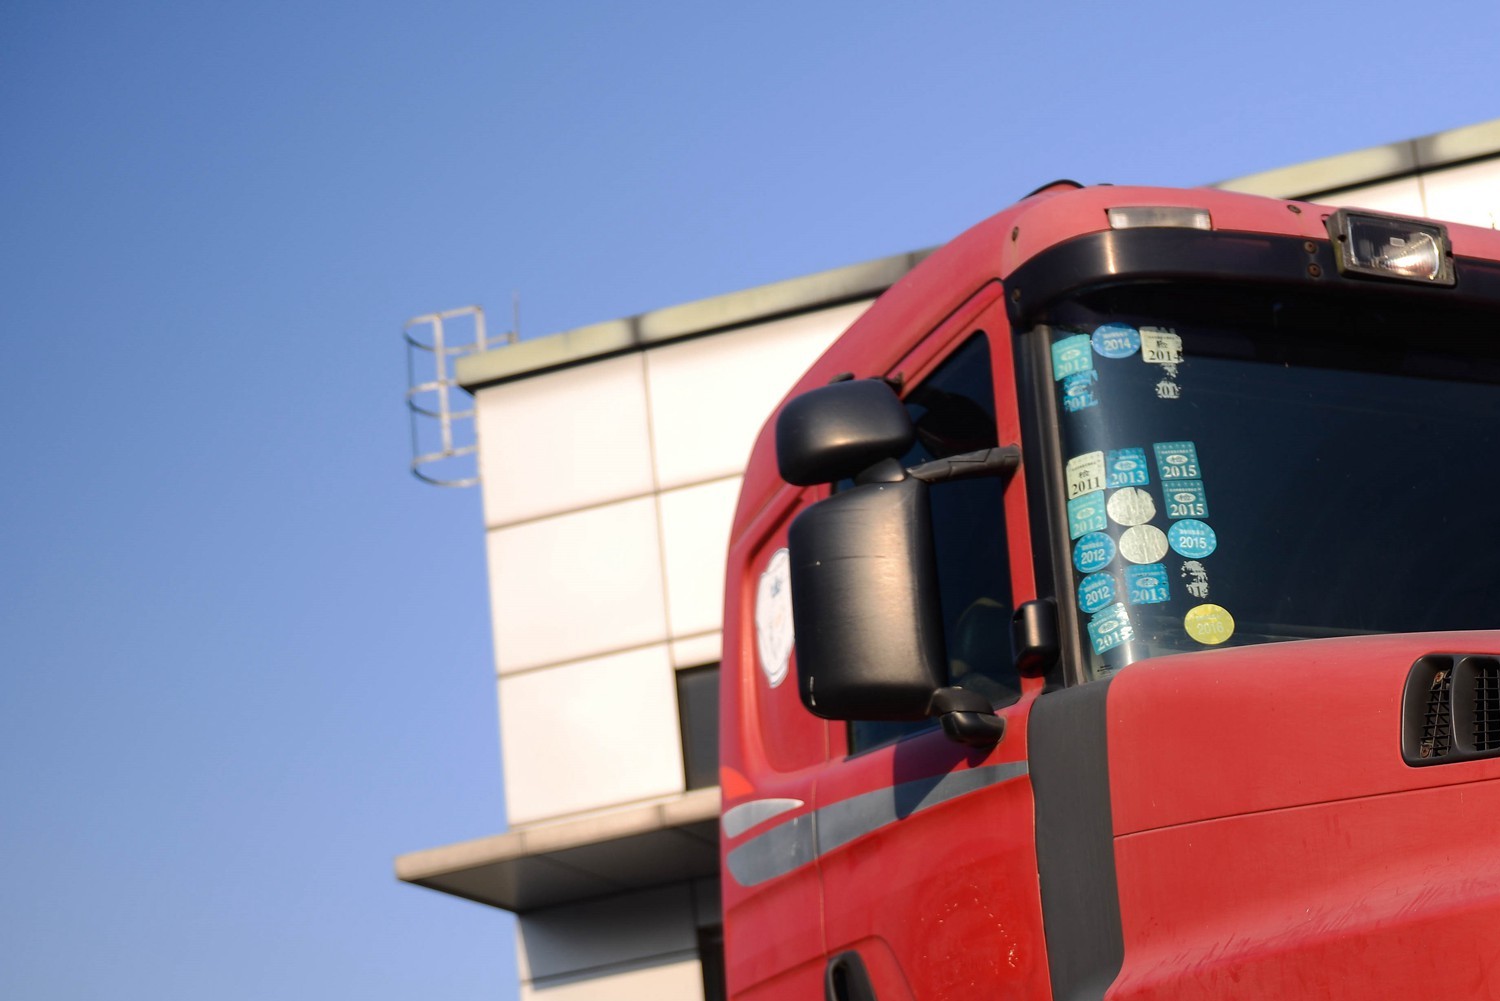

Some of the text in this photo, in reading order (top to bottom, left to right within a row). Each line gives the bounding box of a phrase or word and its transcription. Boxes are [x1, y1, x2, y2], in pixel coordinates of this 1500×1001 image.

[1103, 338, 1131, 351] 2014
[1111, 470, 1146, 485] 2013
[1162, 465, 1197, 478] 2015
[1072, 476, 1100, 496] 2011
[1170, 503, 1205, 516] 2015
[1073, 515, 1104, 537] 2012
[1179, 536, 1207, 549] 2015
[1081, 548, 1105, 565] 2012
[1085, 586, 1111, 606] 2012
[1131, 587, 1168, 603] 2013
